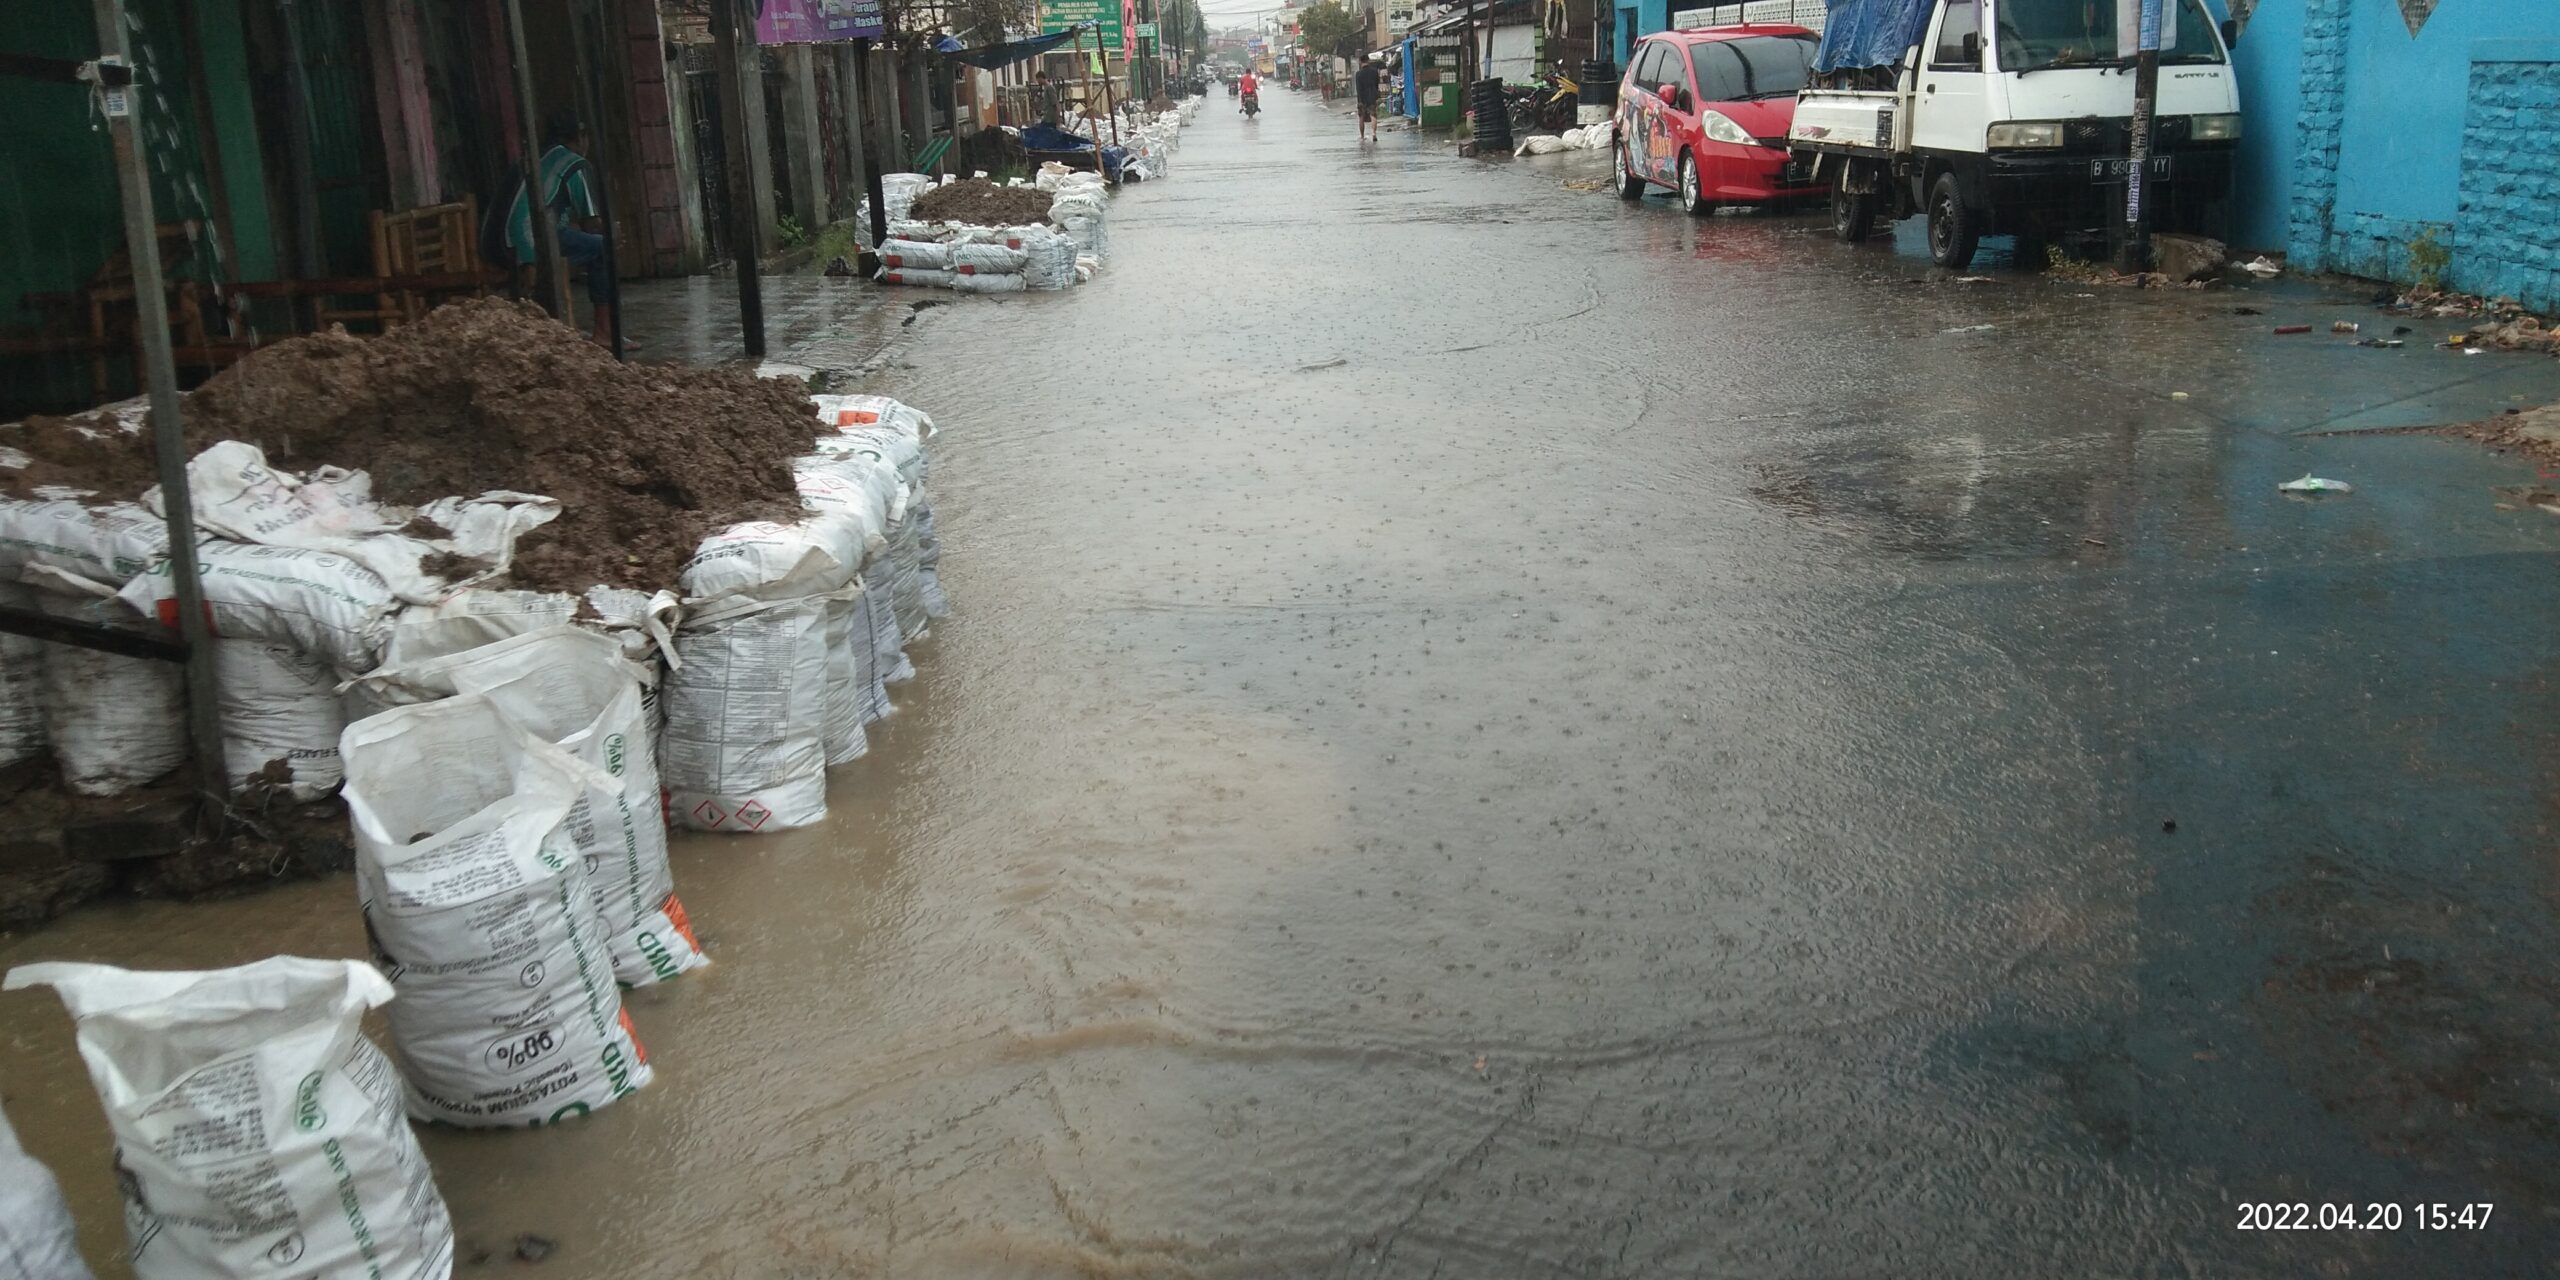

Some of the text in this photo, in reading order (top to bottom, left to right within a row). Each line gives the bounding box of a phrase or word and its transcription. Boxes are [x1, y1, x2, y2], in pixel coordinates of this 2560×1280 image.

[2094, 161, 2103, 176] B
[608, 736, 624, 775] 90%
[496, 1030, 554, 1070] 90%
[300, 1075, 322, 1127] 90%
[487, 1072, 579, 1115] POTASSIUM
